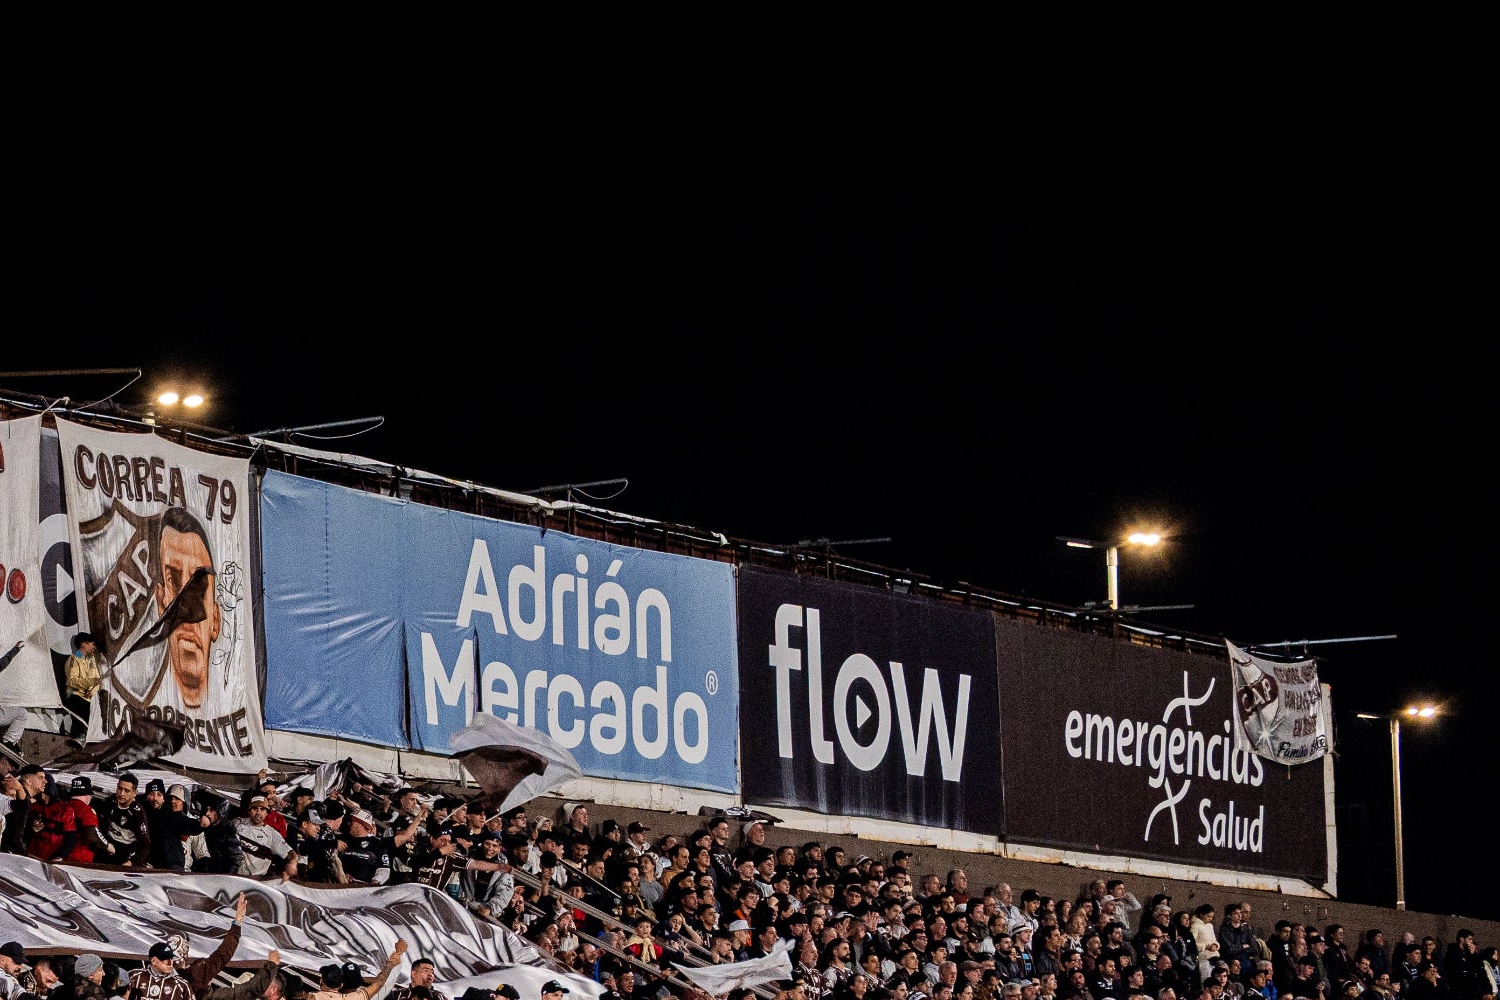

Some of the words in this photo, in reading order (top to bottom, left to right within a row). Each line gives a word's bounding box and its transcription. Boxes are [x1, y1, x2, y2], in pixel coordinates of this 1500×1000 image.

[75, 445, 187, 508] CORREA
[198, 474, 237, 524] 79
[106, 540, 152, 641] CAP
[456, 538, 672, 663] Adrián
[421, 631, 708, 765] Mercado
[769, 603, 971, 783] flow
[1241, 678, 1272, 713] CAP
[1064, 707, 1265, 789] emergencias
[1198, 799, 1265, 855] Salud
